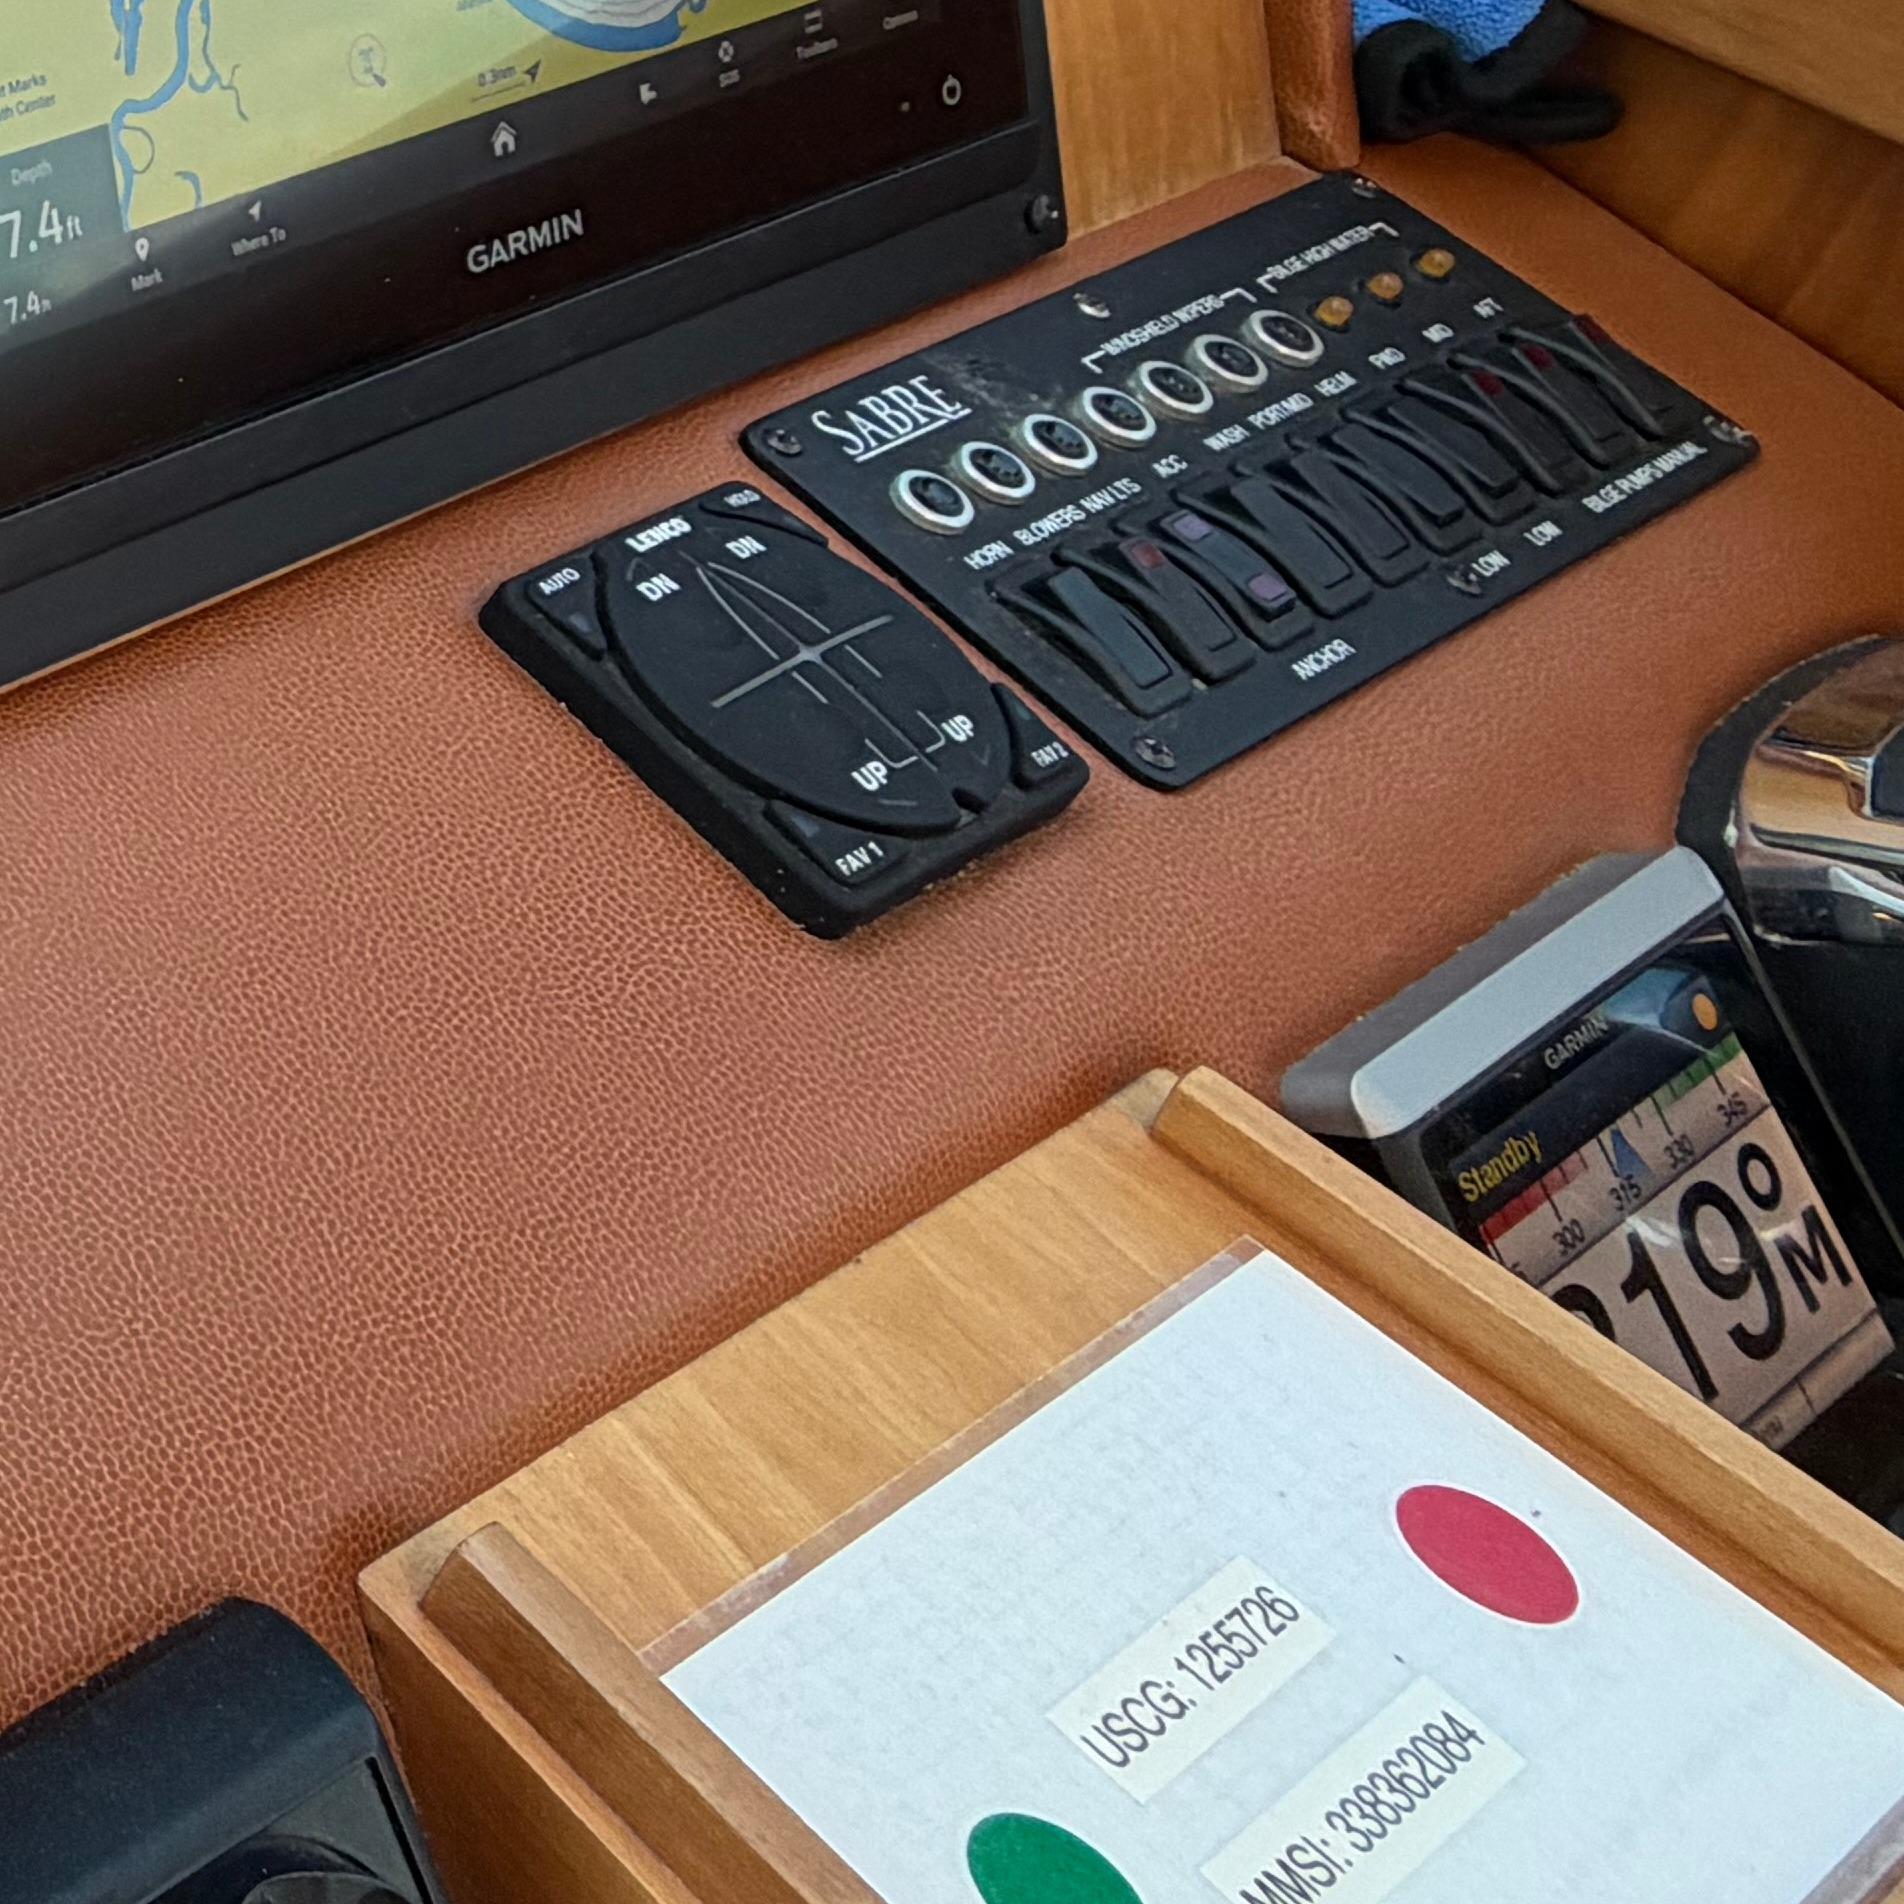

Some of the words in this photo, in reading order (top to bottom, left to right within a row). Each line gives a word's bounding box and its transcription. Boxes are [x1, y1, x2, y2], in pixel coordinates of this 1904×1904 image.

[8, 73, 47, 96] Marks
[11, 161, 52, 186] Depth
[231, 234, 269, 257] Where
[269, 226, 287, 242] To
[467, 208, 584, 273] GARMIN
[1266, 255, 1309, 280] BILGE
[1300, 243, 1337, 264] HIGH
[1329, 225, 1375, 251] WATER
[131, 268, 163, 292] Mark
[1101, 313, 1179, 356] WINDSHIELD
[1172, 294, 1224, 324] WIPERS
[1314, 371, 1357, 396] HELM
[812, 374, 962, 456] SABRE
[1203, 424, 1250, 451] WASH
[1151, 454, 1189, 479] ACC
[1581, 484, 1627, 514] BILGE
[1614, 463, 1664, 495] PUMPS
[1653, 440, 1708, 473] MANUAL
[1079, 492, 1116, 524] NAV
[1110, 476, 1143, 503] LTS
[624, 516, 692, 553] LENCO
[1013, 502, 1086, 547] BLOWERS
[1523, 520, 1563, 546] LOW
[725, 535, 767, 559] DN
[963, 539, 1015, 571] HORN
[1471, 549, 1511, 577] LOW
[539, 567, 581, 596] AUTO
[635, 573, 681, 602] DN
[1292, 637, 1357, 682] ANCHOR
[942, 713, 976, 744] UP
[1030, 745, 1059, 768] FAV
[1055, 741, 1069, 758] 2
[851, 761, 889, 793] UP
[835, 846, 872, 876] FAV
[870, 841, 884, 863] 1
[1544, 1006, 1610, 1070] GARMIN
[1716, 1090, 1748, 1127] 345
[1458, 1129, 1544, 1203] Standby
[1663, 1132, 1695, 1169] 330
[1613, 1176, 1642, 1211] 315
[1552, 1218, 1585, 1255] 300
[1080, 1680, 1201, 1770] USCG:
[1172, 1584, 1300, 1695] 1255726
[1325, 1708, 1486, 1854] 338362084
